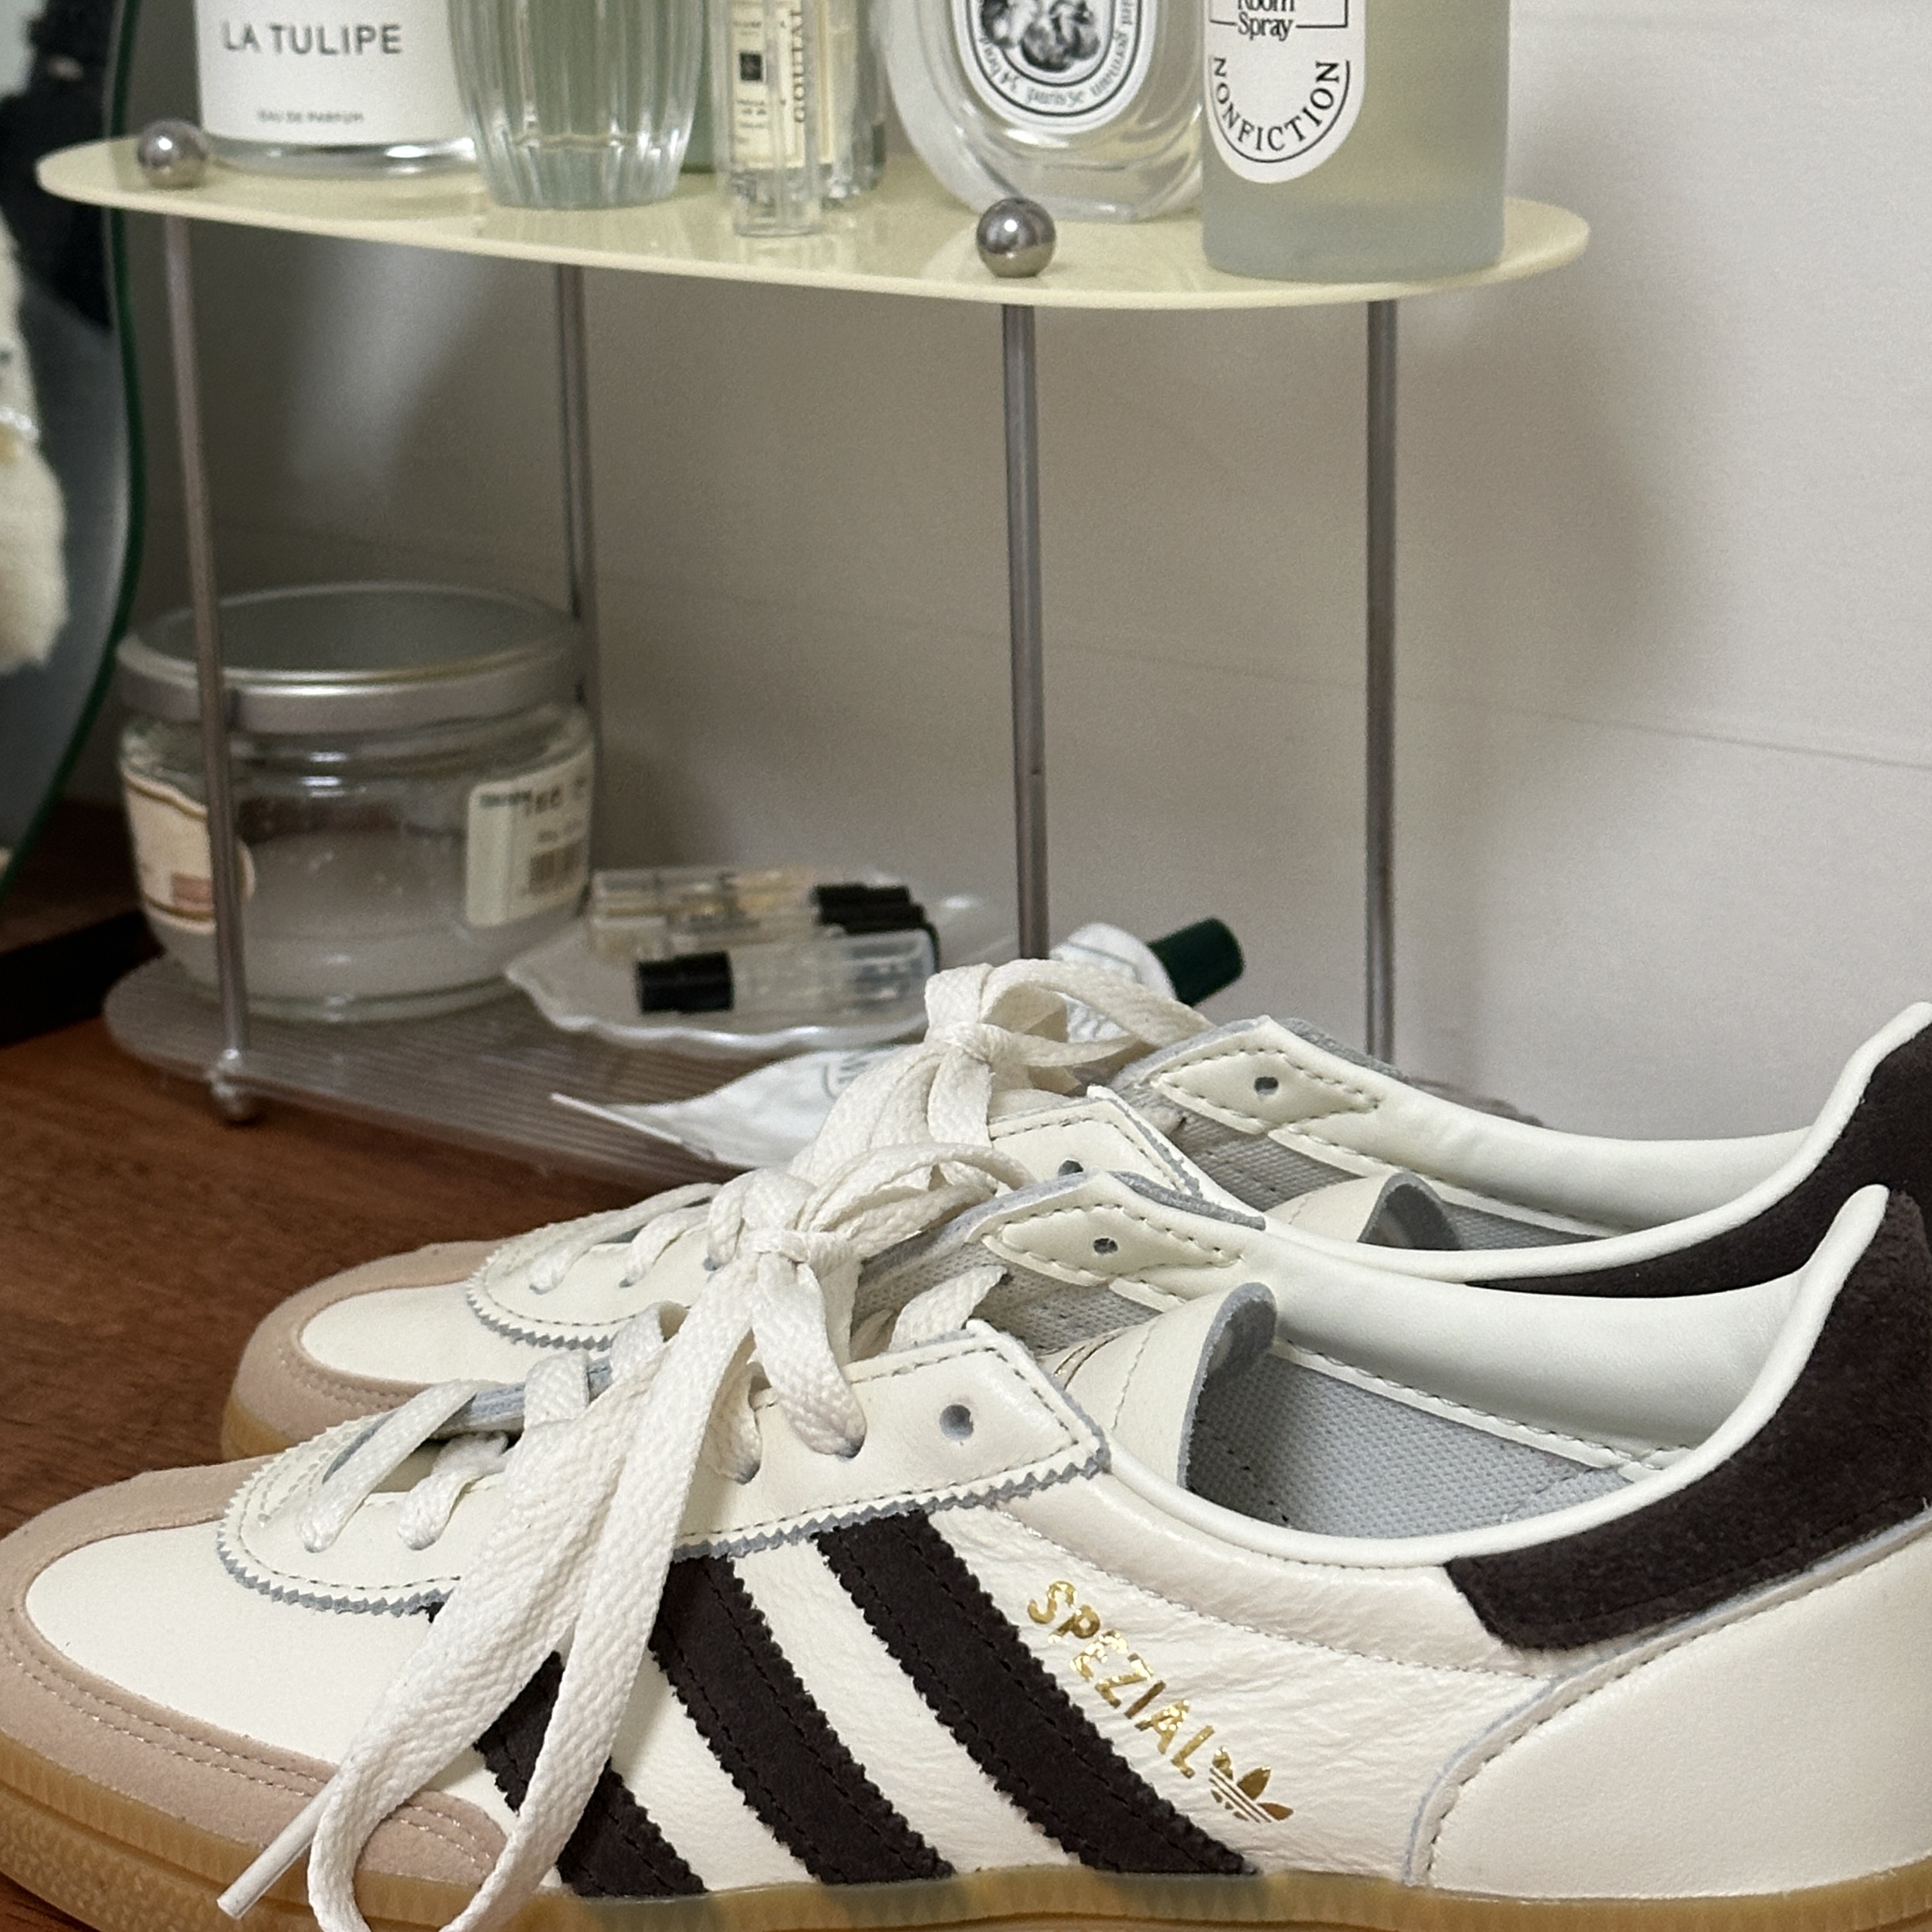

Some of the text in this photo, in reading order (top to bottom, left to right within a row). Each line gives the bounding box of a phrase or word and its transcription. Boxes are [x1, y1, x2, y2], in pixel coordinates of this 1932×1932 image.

[222, 21, 402, 55] LA TULIPE
[1238, 11, 1294, 42] Spray
[1213, 57, 1340, 151] NONFICTION
[1027, 1580, 1215, 1779] SPEZIAL
